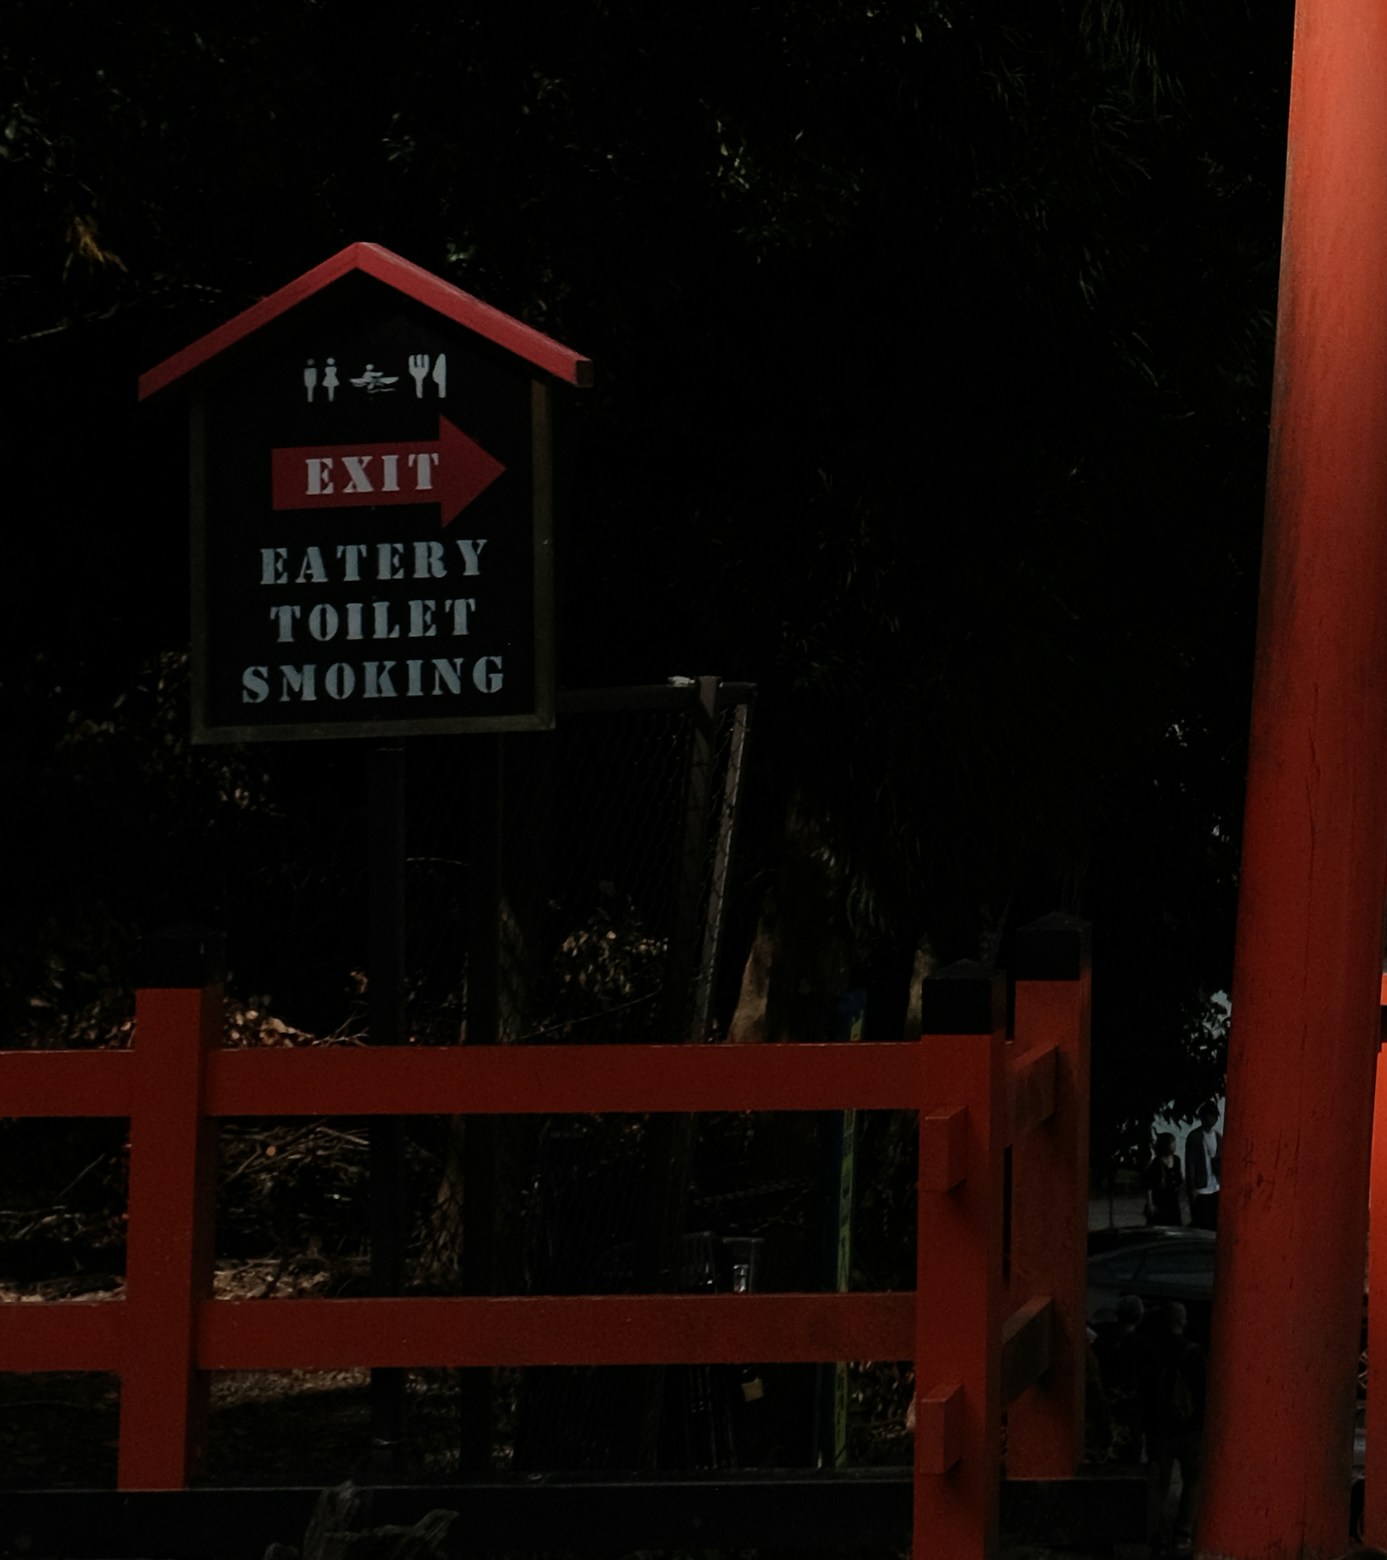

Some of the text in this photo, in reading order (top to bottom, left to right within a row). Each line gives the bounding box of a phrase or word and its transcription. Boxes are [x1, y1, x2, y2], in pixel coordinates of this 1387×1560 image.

[304, 451, 440, 496] EXIT
[259, 538, 488, 585] EATERY
[269, 597, 477, 643] TOILET
[242, 655, 504, 704] SMOKING
